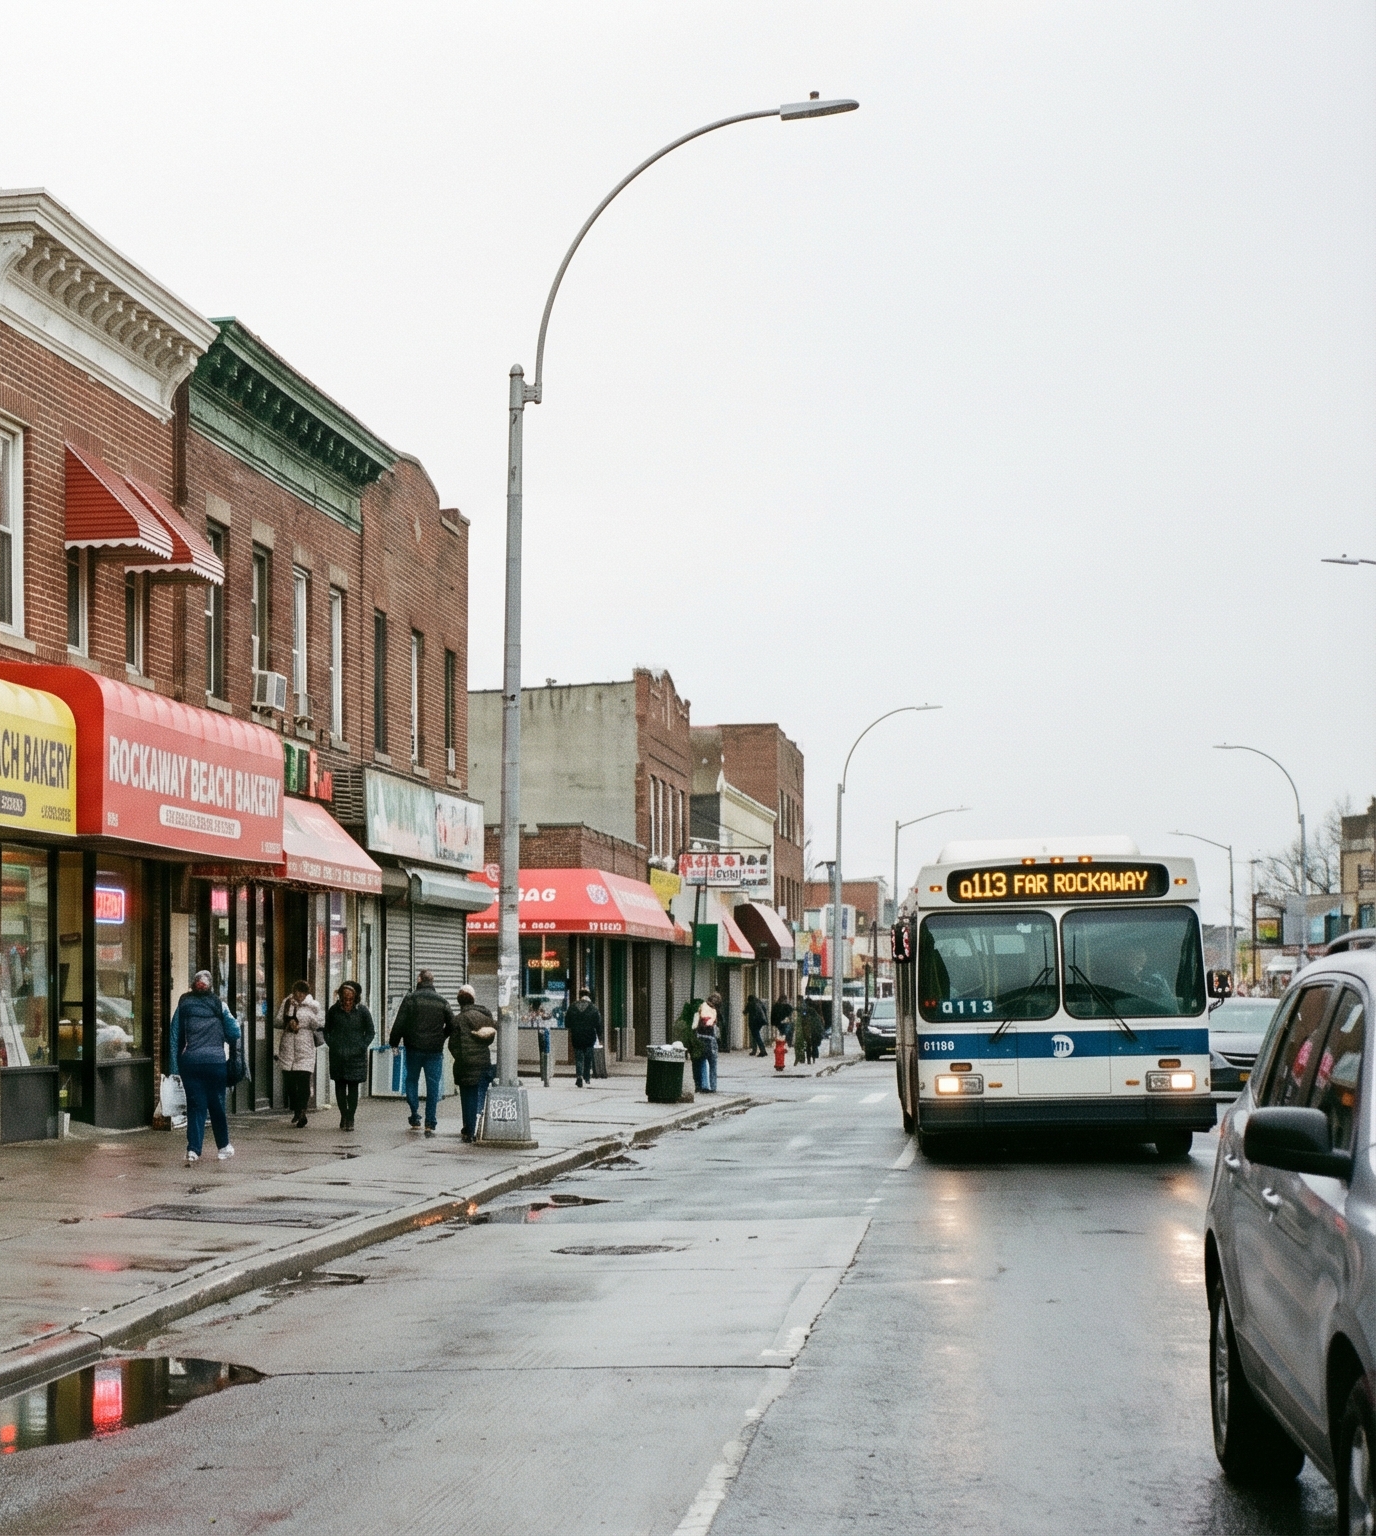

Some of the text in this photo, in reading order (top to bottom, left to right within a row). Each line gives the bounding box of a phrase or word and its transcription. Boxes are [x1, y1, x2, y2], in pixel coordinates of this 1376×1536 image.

[24, 734, 72, 790] BAKERY
[109, 734, 188, 799] ROCKAWAY
[190, 758, 233, 810] BEACH
[235, 770, 281, 819] BAKERY
[959, 870, 1149, 899] Q113 FAR ROCKAWAY
